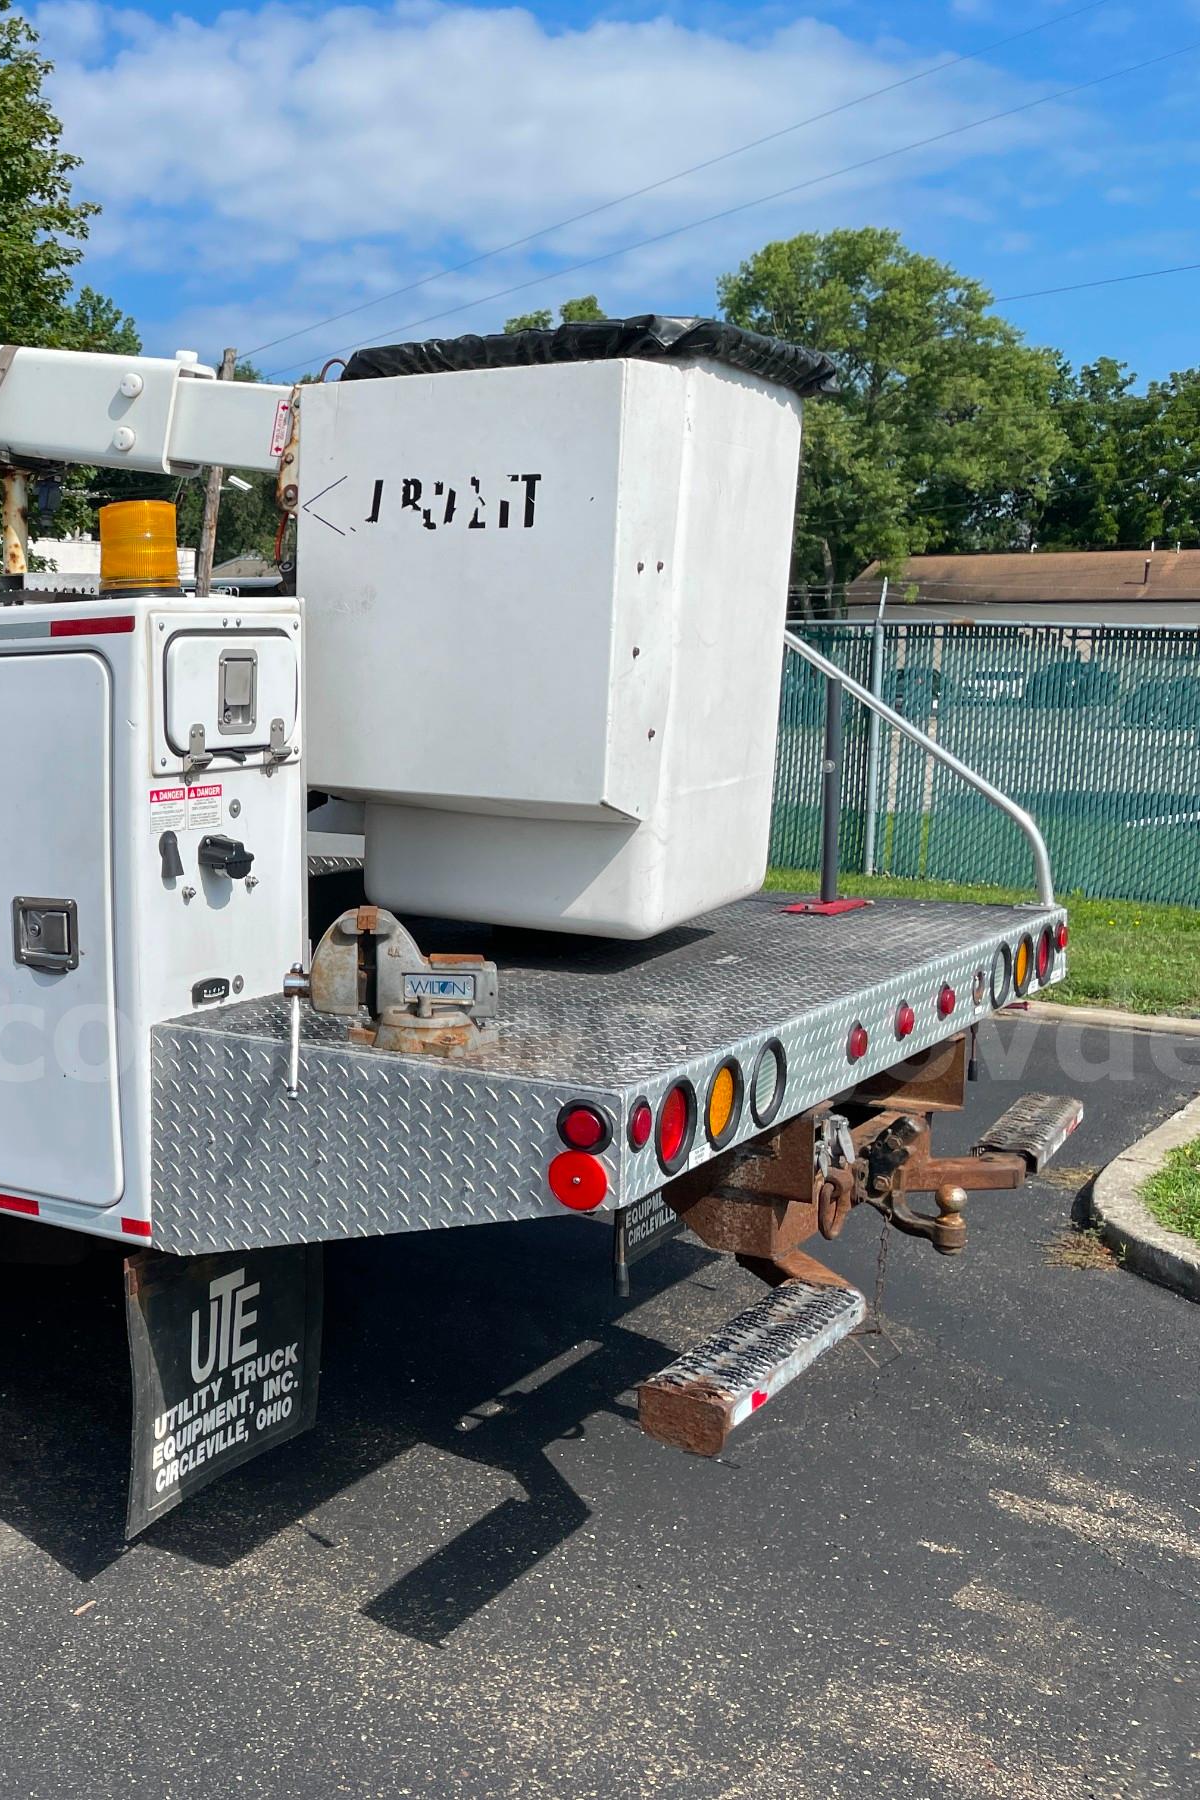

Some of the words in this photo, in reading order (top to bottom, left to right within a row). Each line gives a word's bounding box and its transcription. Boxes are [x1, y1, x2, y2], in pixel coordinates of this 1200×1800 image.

[159, 790, 184, 801] DANGER
[196, 786, 220, 797] DANGER
[410, 980, 466, 996] WILTON
[190, 1267, 260, 1384] UTE
[152, 1389, 254, 1470] EQUIPMENT,
[263, 1370, 299, 1402] INC.
[154, 1377, 223, 1440] UTILITY
[231, 1342, 298, 1390] TRUCK
[155, 1419, 249, 1493] CIRCLEVILLE,
[256, 1396, 293, 1431] OHIO
